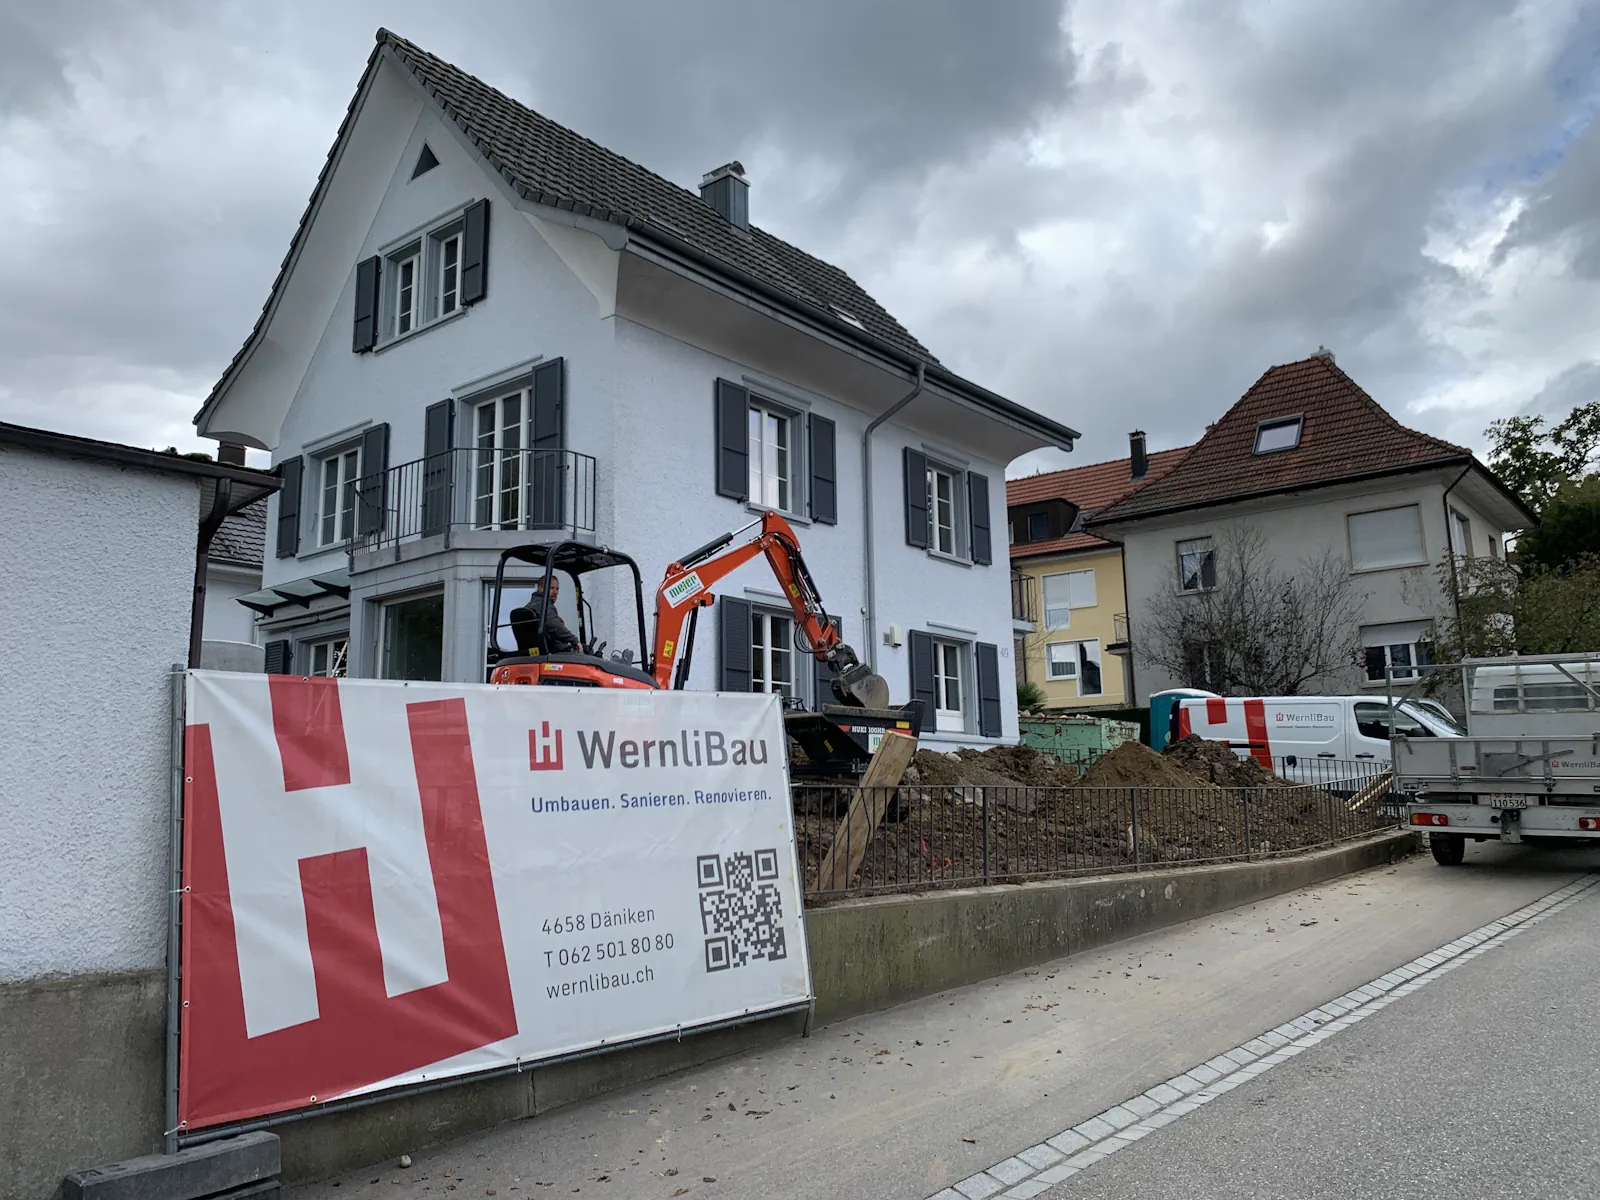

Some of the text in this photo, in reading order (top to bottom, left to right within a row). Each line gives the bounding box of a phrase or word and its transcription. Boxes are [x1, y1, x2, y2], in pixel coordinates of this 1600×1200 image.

[669, 575, 697, 598] meier
[1286, 713, 1335, 722] WernliBau
[577, 729, 768, 770] WernliBau
[1561, 760, 1600, 768] WernliBa
[531, 788, 772, 813] Umbauen. Sanieren. Renovieren.
[542, 908, 655, 935] 4658 Däniken
[559, 948, 591, 966] 062
[596, 940, 627, 960] 501
[631, 936, 651, 955] 80
[655, 933, 674, 951] 80
[546, 965, 654, 999] wernlibau.ch
